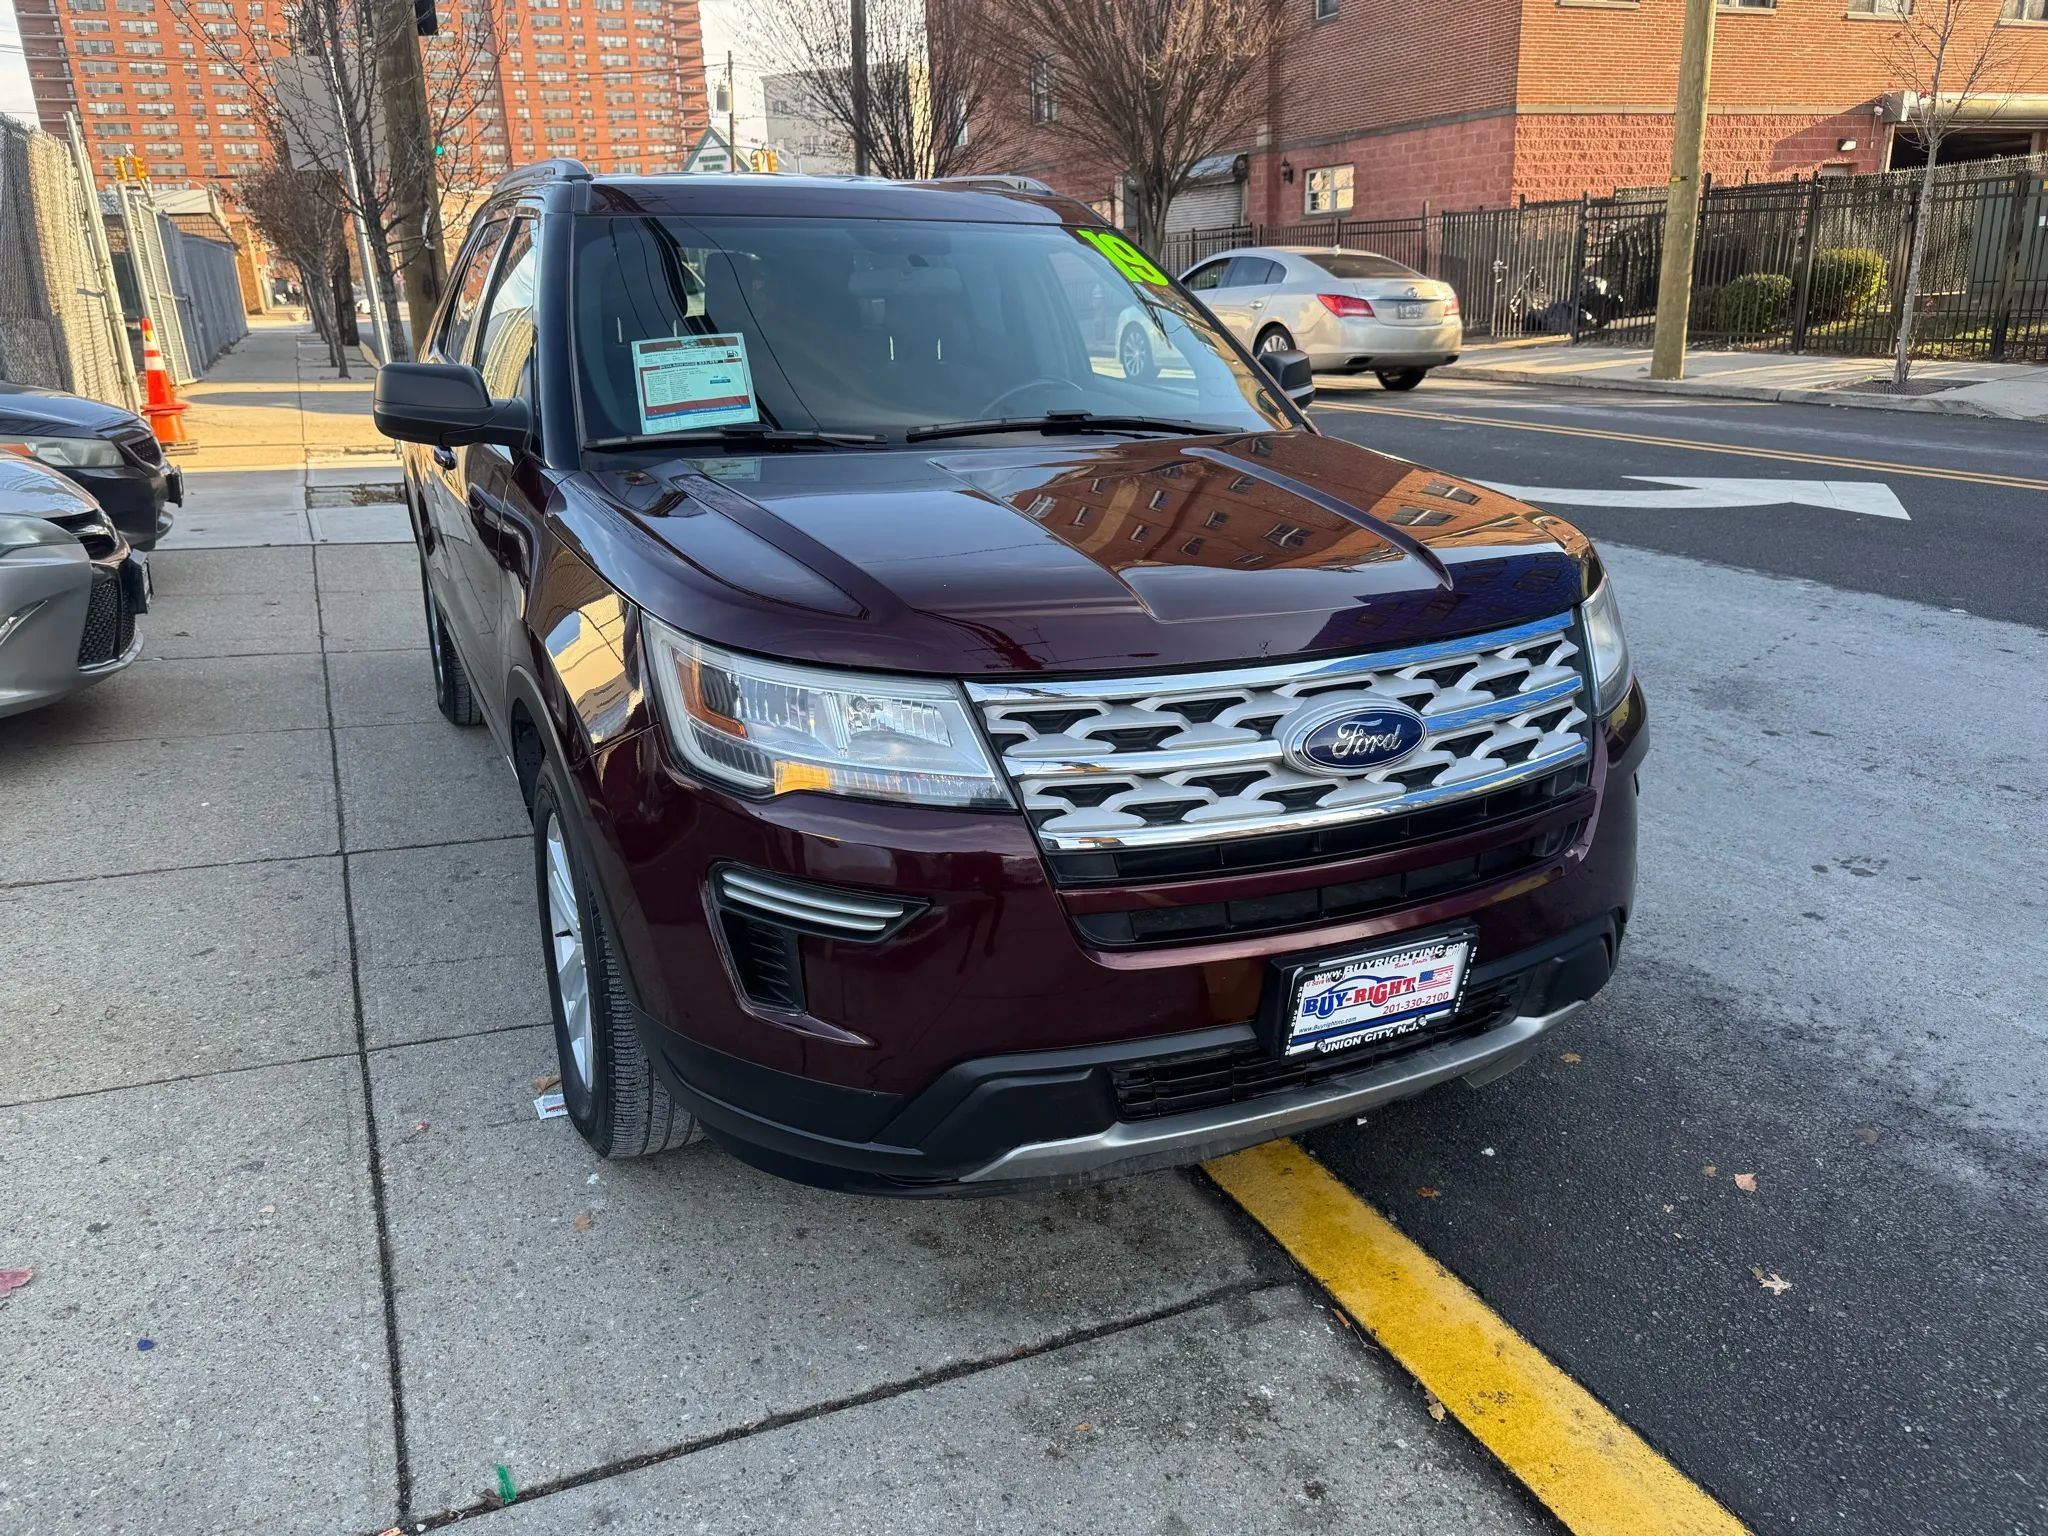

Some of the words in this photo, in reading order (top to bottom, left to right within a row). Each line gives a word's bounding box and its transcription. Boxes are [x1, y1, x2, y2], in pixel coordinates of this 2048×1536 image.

[1076, 230, 1168, 285] 19
[1331, 718, 1402, 759] Ford
[1303, 976, 1417, 1018] BUY-RIGHT
[1382, 991, 1449, 1015] 201-330-2100
[1321, 1036, 1362, 1053] UNION
[1364, 1028, 1394, 1043] CITY,
[1397, 1023, 1419, 1036] N.J.
